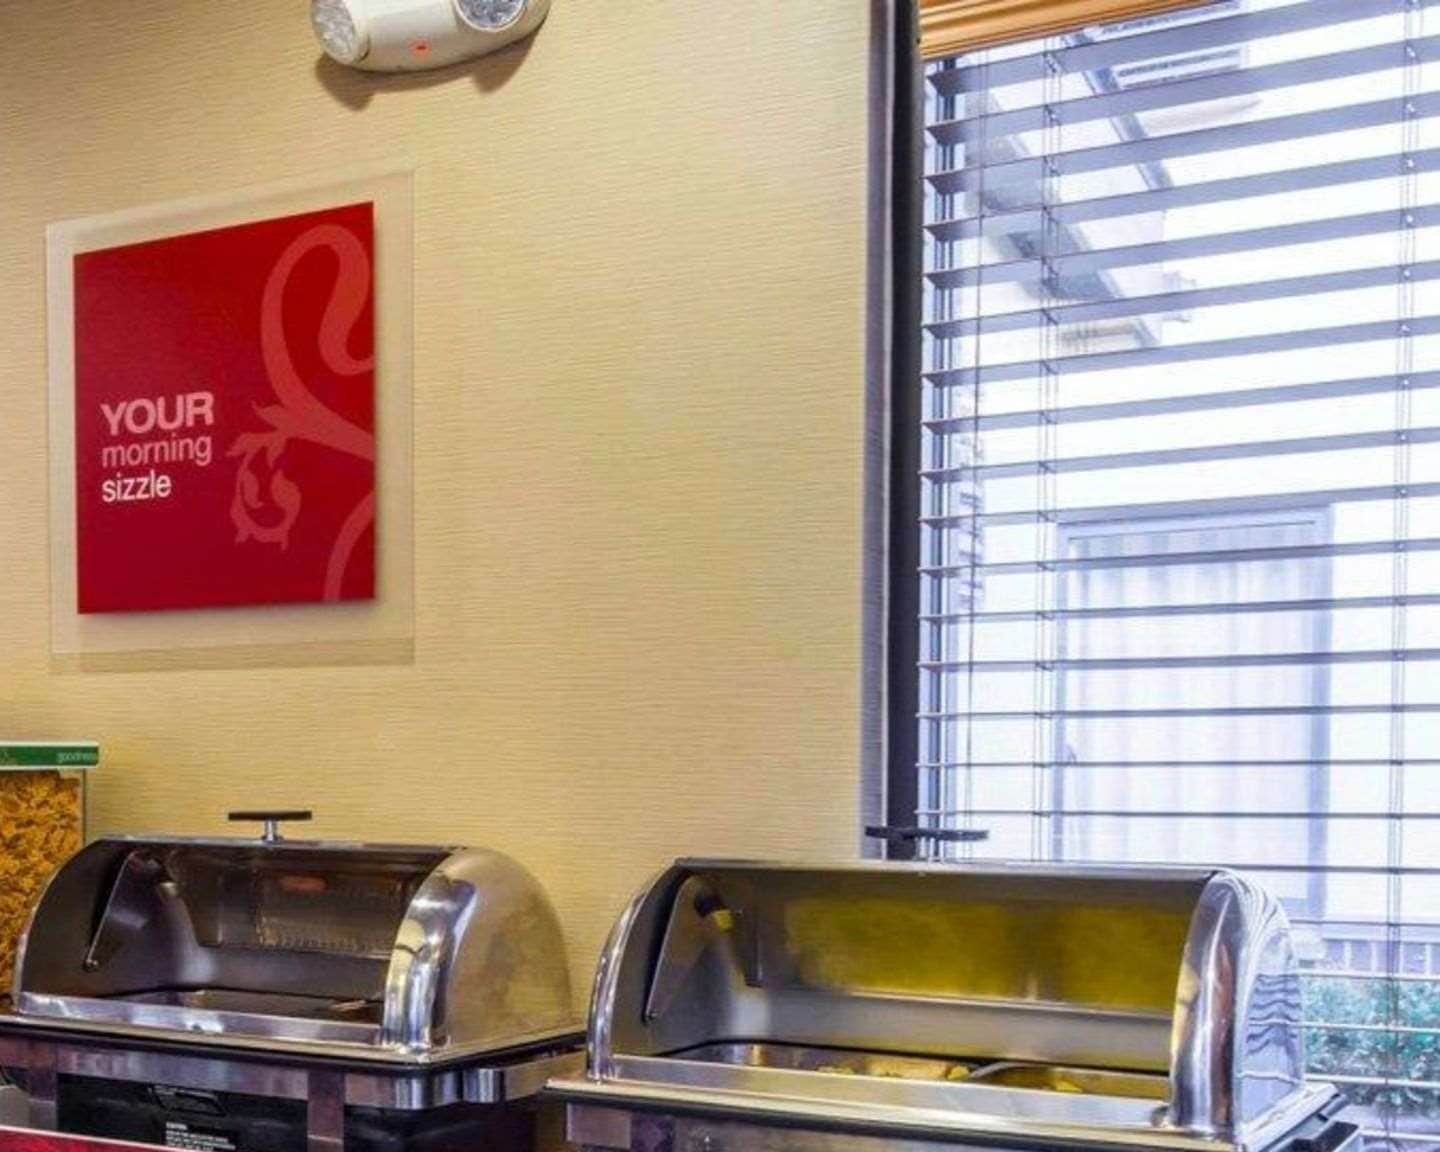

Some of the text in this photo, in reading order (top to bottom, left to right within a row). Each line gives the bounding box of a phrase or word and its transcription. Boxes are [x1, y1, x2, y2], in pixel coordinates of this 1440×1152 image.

[101, 391, 215, 436] YOUR
[101, 432, 213, 468] morning
[101, 469, 173, 503] sizzle
